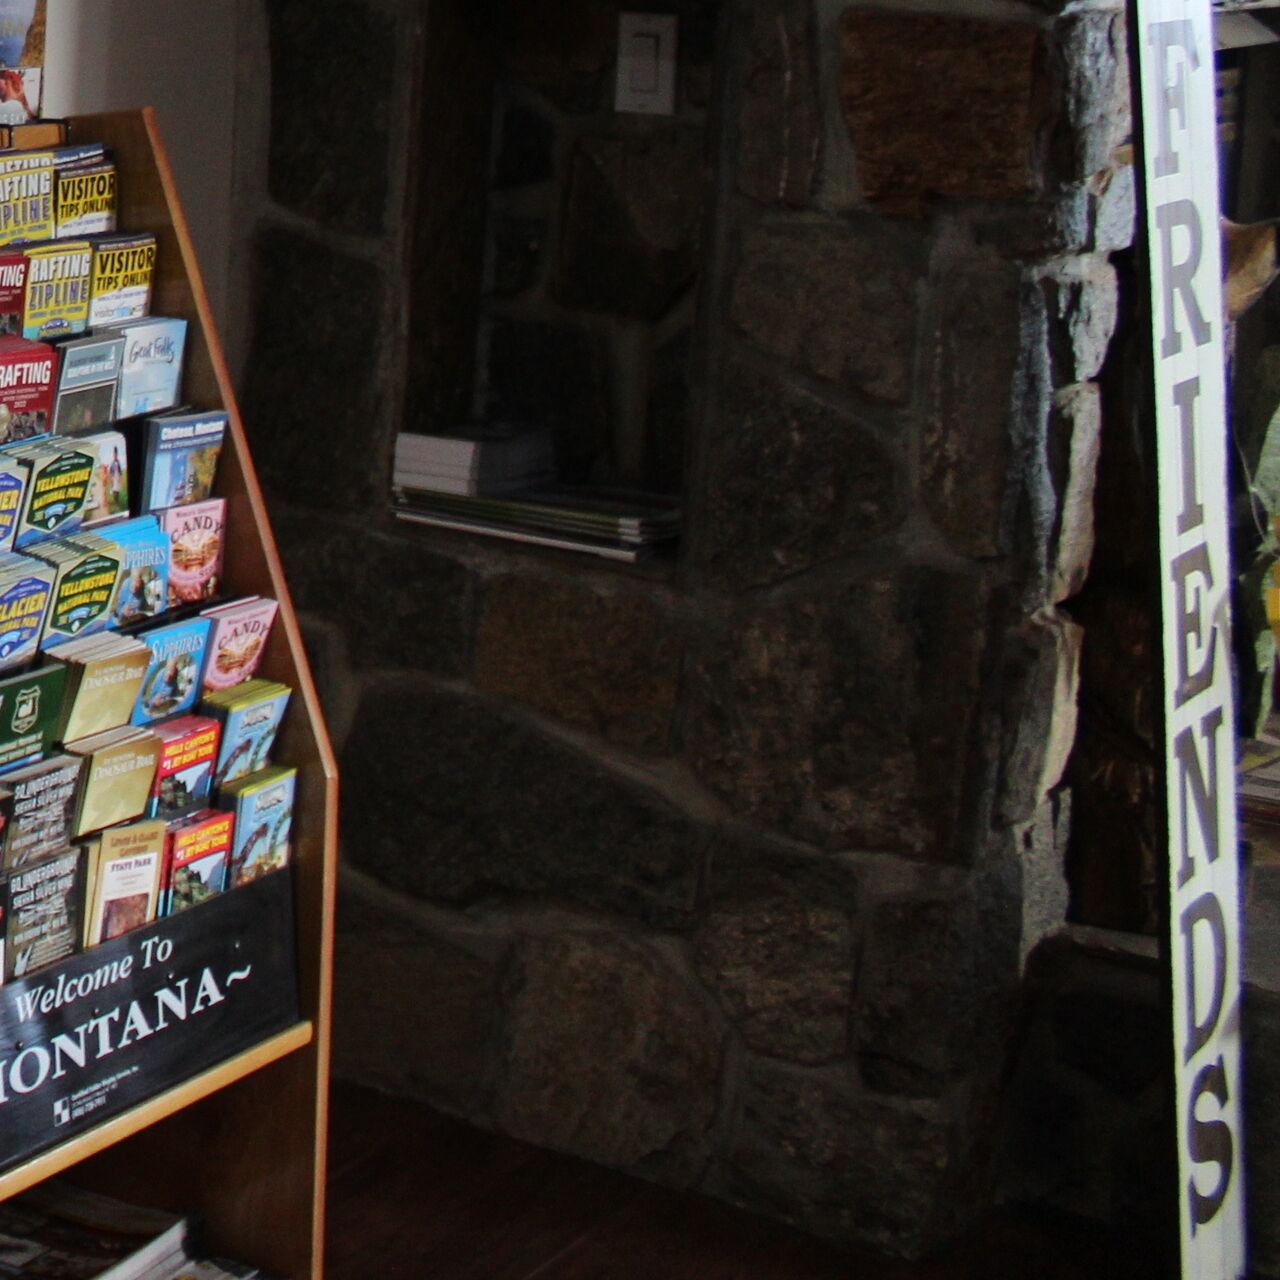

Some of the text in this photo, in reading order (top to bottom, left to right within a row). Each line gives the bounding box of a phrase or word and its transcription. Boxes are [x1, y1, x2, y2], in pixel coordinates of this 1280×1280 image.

[60, 174, 116, 203] VISITOR
[60, 203, 79, 219] TIPS
[30, 254, 90, 282] RAFTING
[99, 246, 154, 274] VISITOR
[29, 280, 89, 310] ZIPLINE
[97, 276, 118, 291] TIPS
[36, 468, 91, 493] YELLOWSTONE
[171, 516, 224, 544] CANDY
[60, 570, 116, 597] YELLOWSTONE
[218, 619, 270, 651] CANDY
[1147, 18, 1234, 1240] FRIENDS
[150, 634, 204, 666] SAPPHIRES
[111, 857, 152, 872] STATE PARK
[16, 952, 134, 1023] Welcome
[140, 935, 173, 970] To
